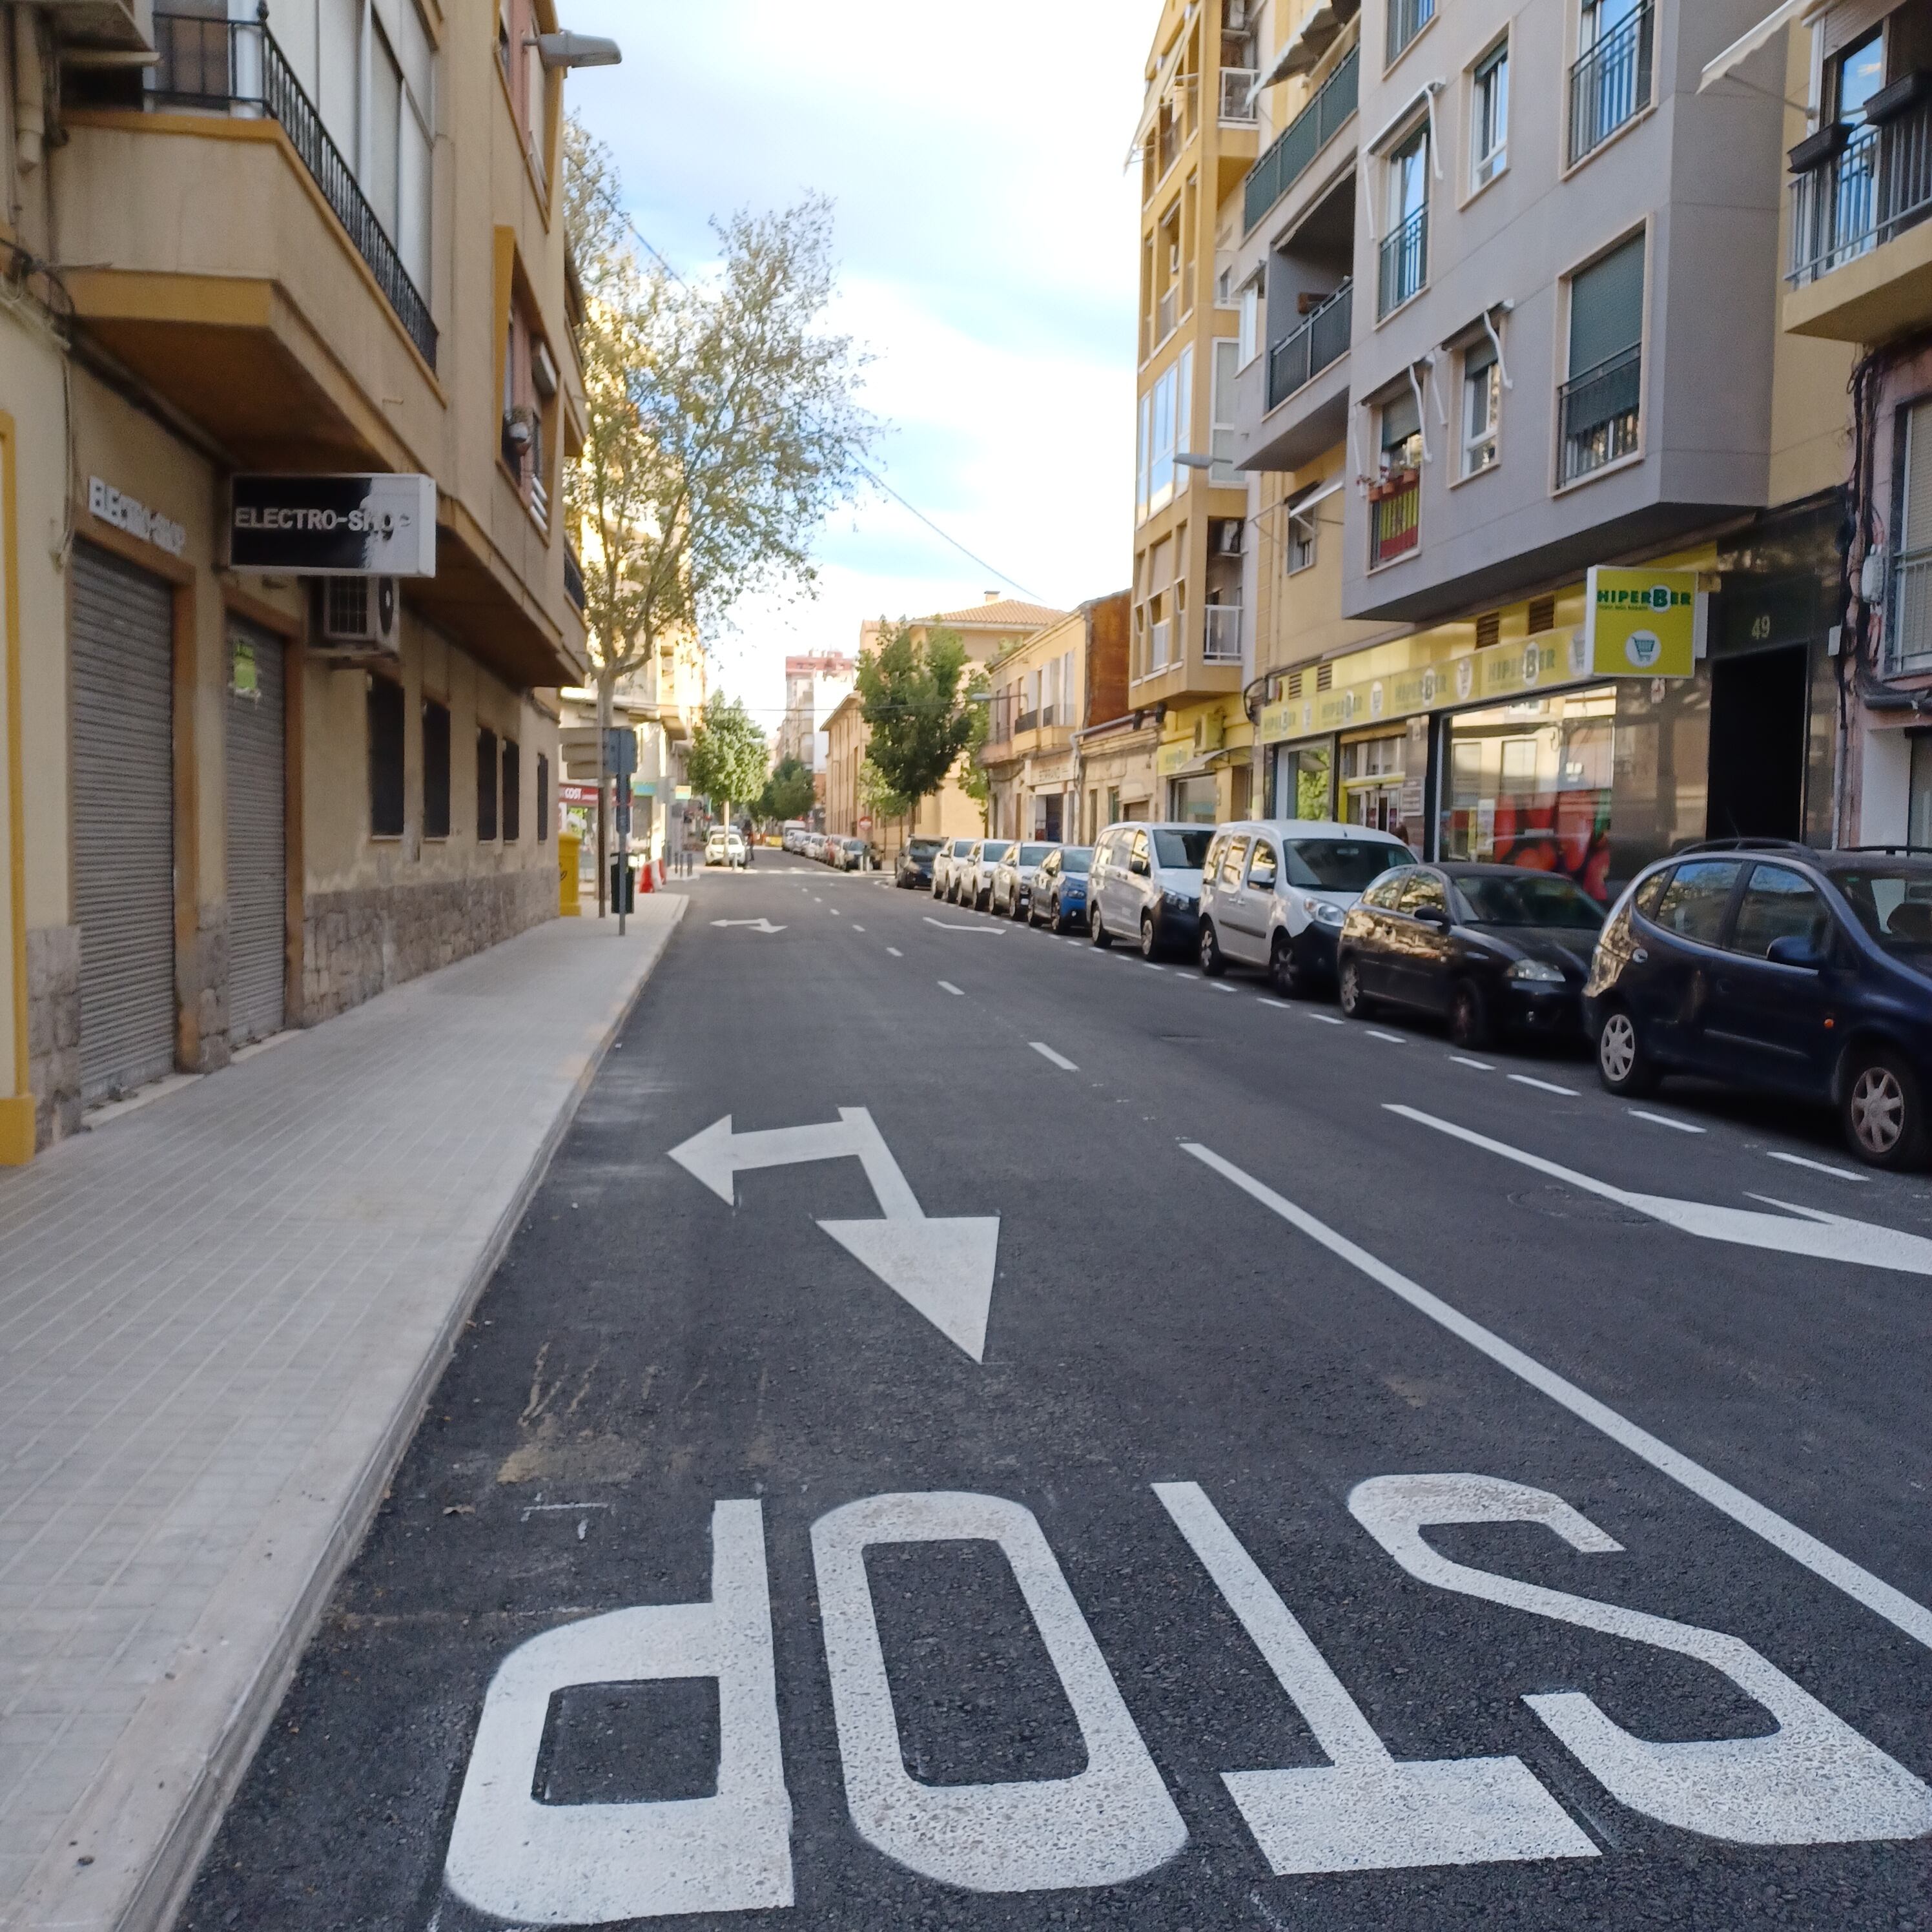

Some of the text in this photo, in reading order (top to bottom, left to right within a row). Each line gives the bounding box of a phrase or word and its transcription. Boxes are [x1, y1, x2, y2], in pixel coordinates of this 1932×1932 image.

[1597, 589, 1691, 607] HIPERBER
[1751, 615, 1770, 640] 49
[444, 1472, 1932, 1926] STOP
